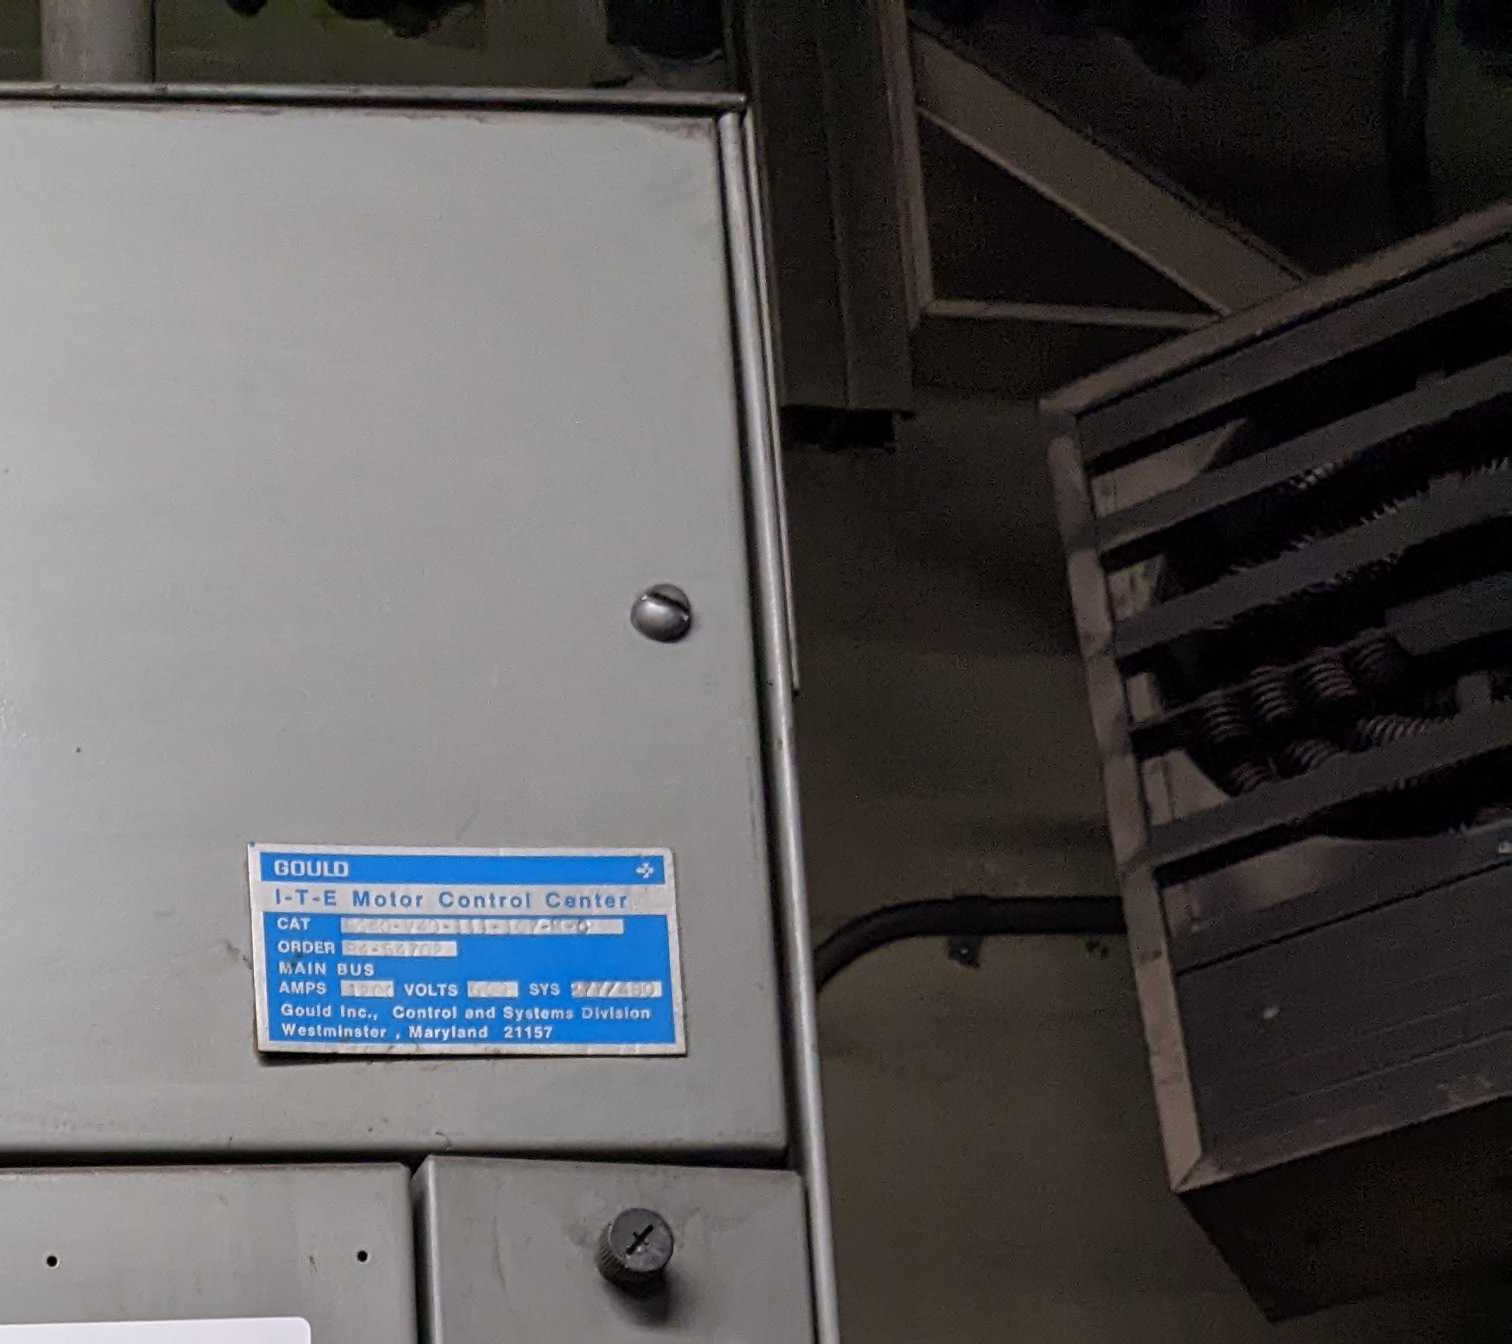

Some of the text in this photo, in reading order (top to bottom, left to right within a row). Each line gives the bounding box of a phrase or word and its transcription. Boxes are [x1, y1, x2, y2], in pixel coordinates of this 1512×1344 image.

[273, 860, 349, 878] GOULD
[274, 889, 628, 910] I-T-E Motor Control Center
[276, 917, 311, 932] CAT
[278, 941, 336, 955] ORDER
[279, 962, 375, 976] MAIN BUS
[279, 982, 327, 996] AMPS
[404, 983, 458, 997] VOLTS
[529, 983, 560, 997] SYS
[280, 1003, 332, 1019] Gould
[392, 1005, 458, 1020] Control
[464, 1005, 496, 1020] and
[503, 1006, 574, 1023] Systems
[582, 1006, 651, 1020] Division
[408, 1025, 488, 1041] Maryland
[504, 1026, 553, 1040] 21157
